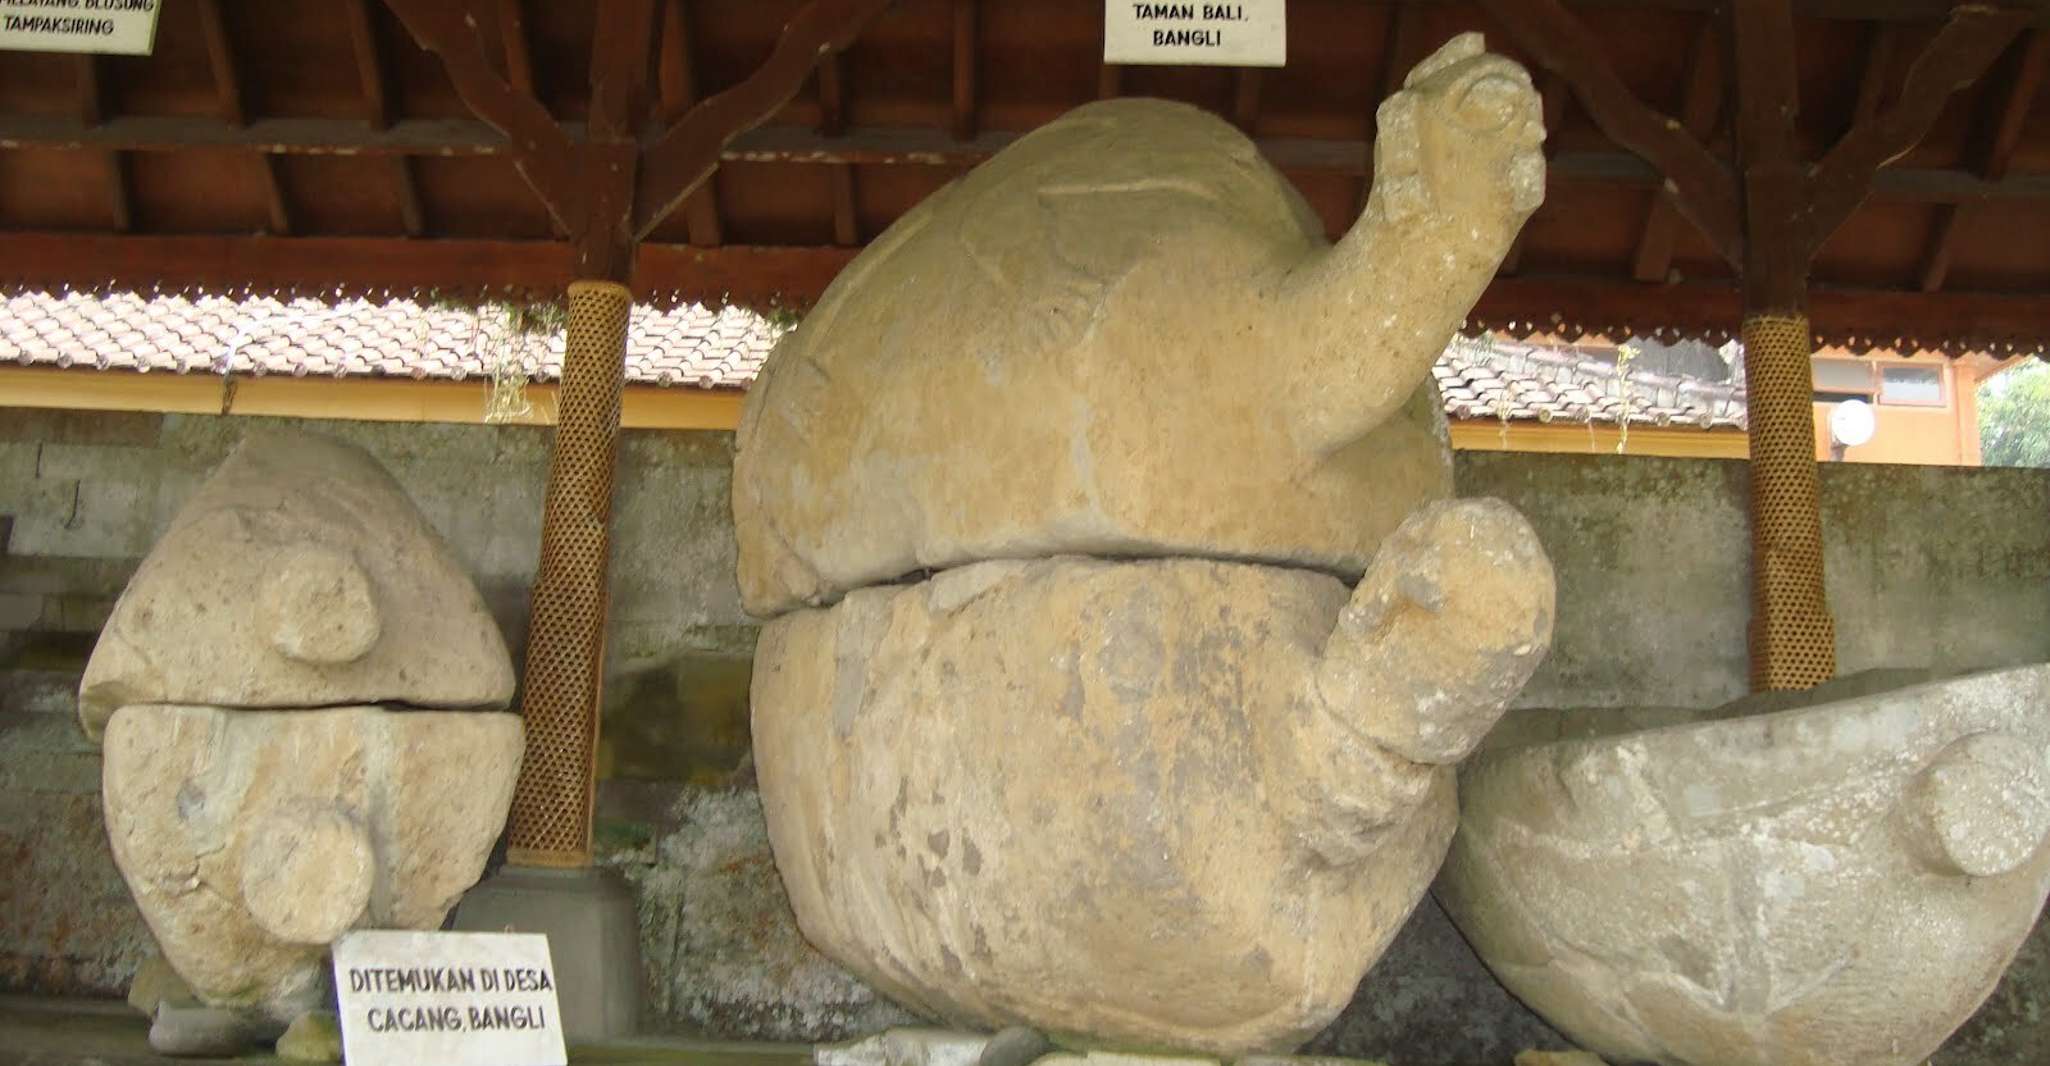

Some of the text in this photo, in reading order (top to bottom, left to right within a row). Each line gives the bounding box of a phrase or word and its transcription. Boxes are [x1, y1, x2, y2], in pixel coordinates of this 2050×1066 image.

[1133, 4, 1194, 20] TAMAN
[4, 14, 114, 35] TAMPAKSIRING
[1153, 30, 1221, 46] BANGLI
[350, 967, 552, 992] DITEMUKAN DI DESA
[469, 1005, 545, 1030] BANGLI
